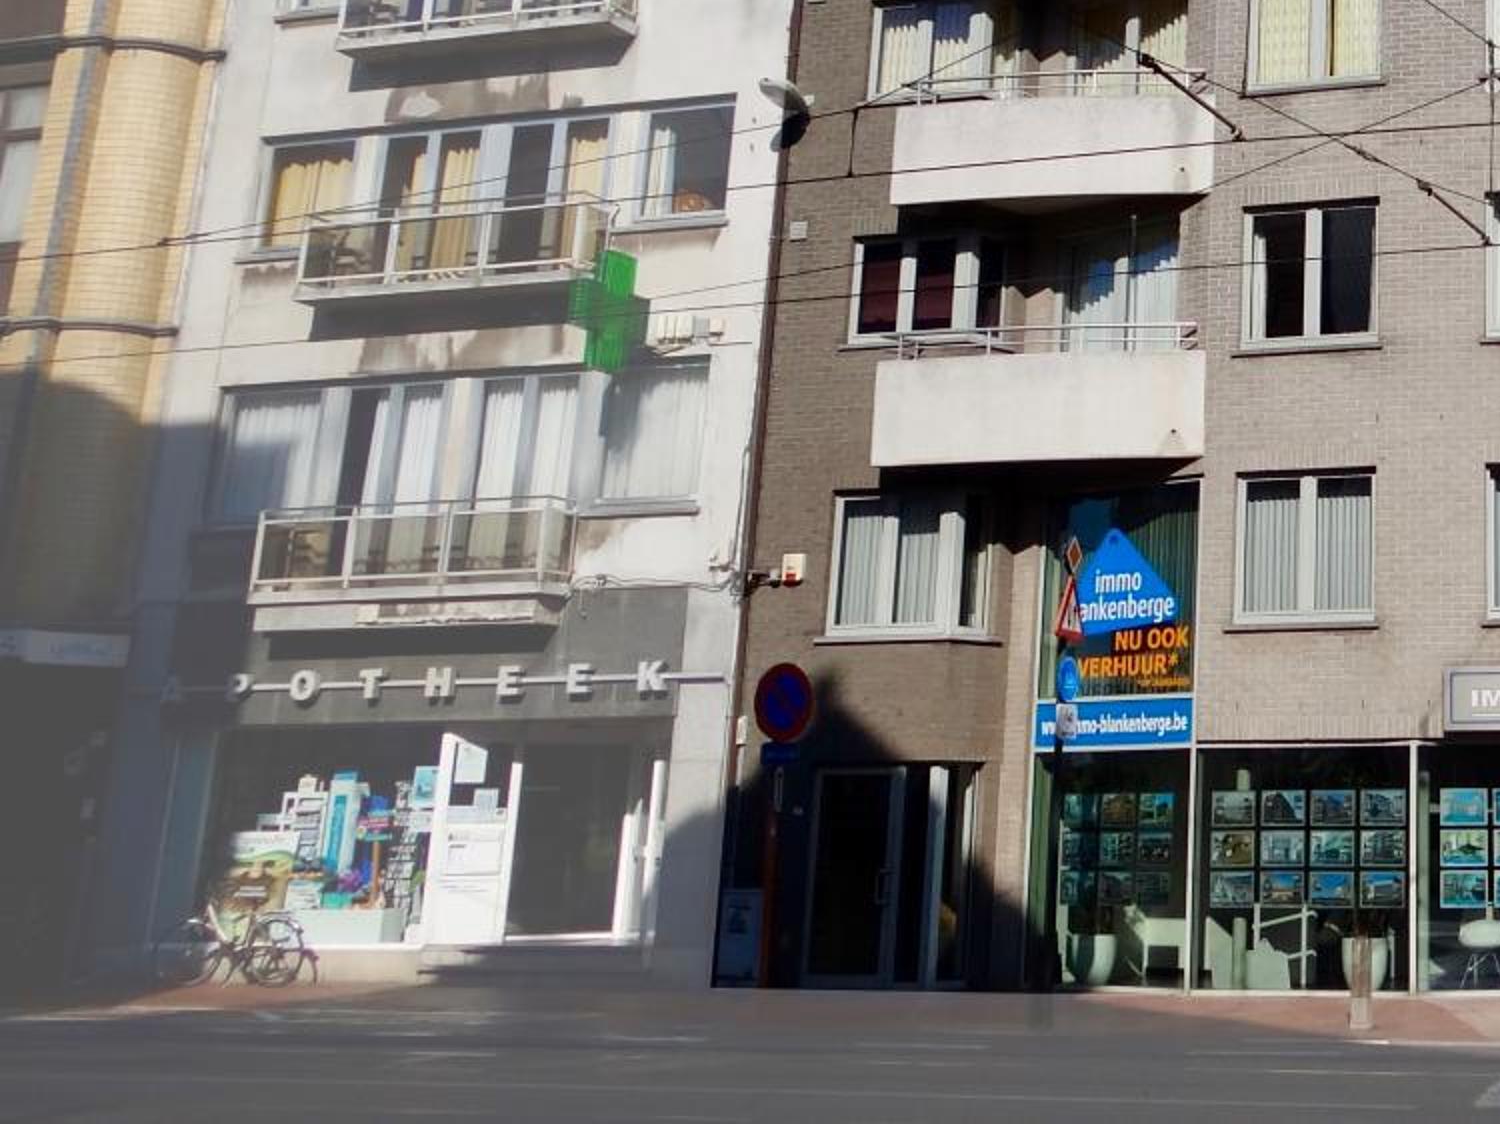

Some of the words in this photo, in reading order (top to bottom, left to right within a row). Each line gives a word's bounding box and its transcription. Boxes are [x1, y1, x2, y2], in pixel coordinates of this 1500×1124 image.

[1094, 569, 1142, 594] immo
[1080, 593, 1175, 623] ankenberge
[1115, 630, 1143, 651] NU
[1147, 624, 1190, 650] OOK
